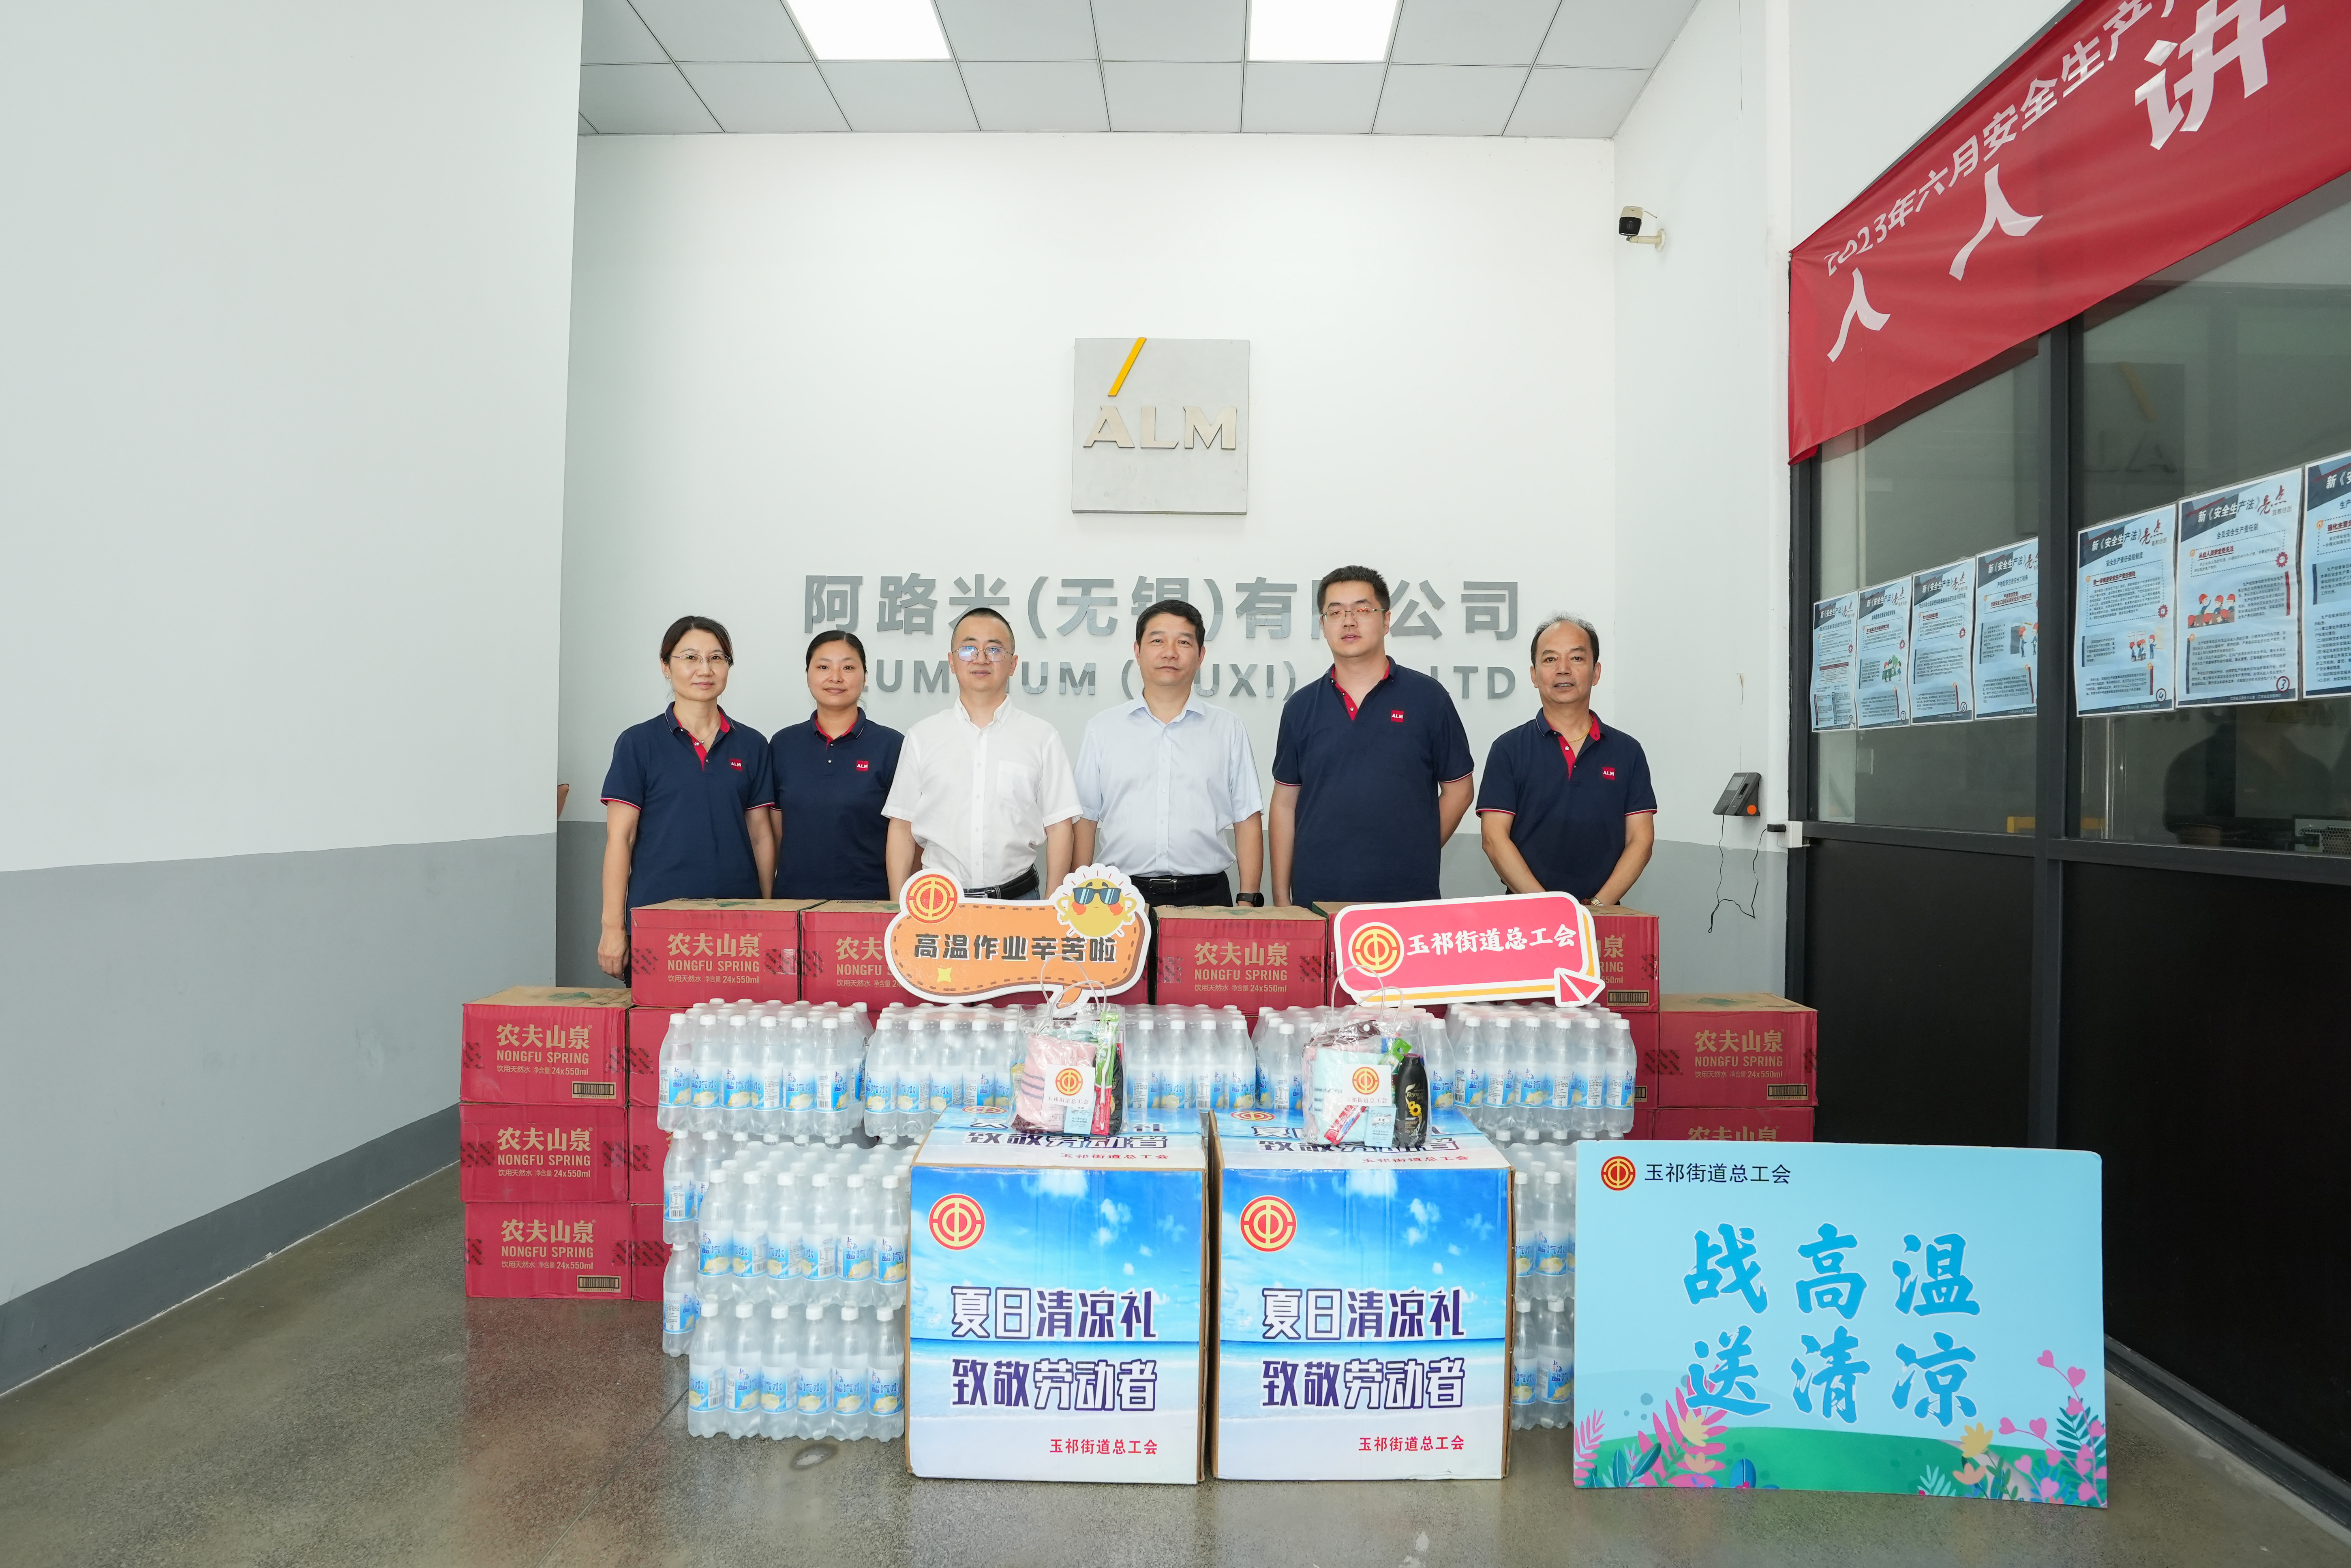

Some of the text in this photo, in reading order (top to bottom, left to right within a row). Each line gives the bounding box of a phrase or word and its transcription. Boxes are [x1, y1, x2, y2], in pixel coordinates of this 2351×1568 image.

[1824, 0, 2174, 276] 2023年六月安全生产
[1083, 405, 1237, 450] ALM
[1121, 659, 1296, 700] (UXI)
[667, 932, 760, 958] 农夫山泉
[835, 936, 883, 961] 农夫
[914, 933, 1117, 963] 高温作业辛苦啦
[1406, 923, 1577, 956] 玉祁街道总工会
[1194, 941, 1289, 967] 农夫山泉
[668, 960, 713, 972] NONGFU
[717, 960, 760, 972] SPRING
[836, 964, 882, 976] NONGFU
[1195, 969, 1287, 981] NONGFU SPRING
[1600, 962, 1623, 973] RING
[723, 975, 760, 984] 24x550ml
[1194, 984, 1229, 992] 饮用天然水
[1250, 984, 1287, 992] 24x550ml
[496, 1024, 591, 1050] 农夫山泉
[1694, 1029, 1784, 1053] 农夫山泉
[497, 1050, 542, 1064] NONGFU
[546, 1051, 589, 1065] SPRING
[1695, 1056, 1738, 1067] NONGFU
[1743, 1056, 1783, 1067] SPRING
[497, 1065, 589, 1076] 饮用天然水 净含量 24x550ml
[1747, 1070, 1783, 1078] 24x550ml
[1049, 1096, 1089, 1105] 玉祁街道总工会
[497, 1127, 591, 1152] 农夫山泉
[964, 1132, 1168, 1148] 致敬劳动者
[498, 1154, 591, 1166] NONGFU SPRING
[554, 1170, 591, 1178] 24x550ml
[1644, 1162, 1792, 1185] 玉祁街道总工会
[501, 1219, 594, 1244] 农夫山泉
[501, 1246, 593, 1258] NONGFU SPRING
[557, 1262, 593, 1270] 24x550ml
[1683, 1223, 1981, 1319] 战高温
[951, 1286, 1156, 1339] 夏日清凉礼
[1263, 1285, 1465, 1340] 夏日清凉礼
[951, 1358, 1157, 1411] 致敬劳动者
[1262, 1357, 1465, 1409] 致敬劳动者
[1685, 1326, 1977, 1427] 送清凉
[1050, 1438, 1158, 1455] 玉祁街道总工会
[1358, 1435, 1465, 1452] 玉祁街道总工会
